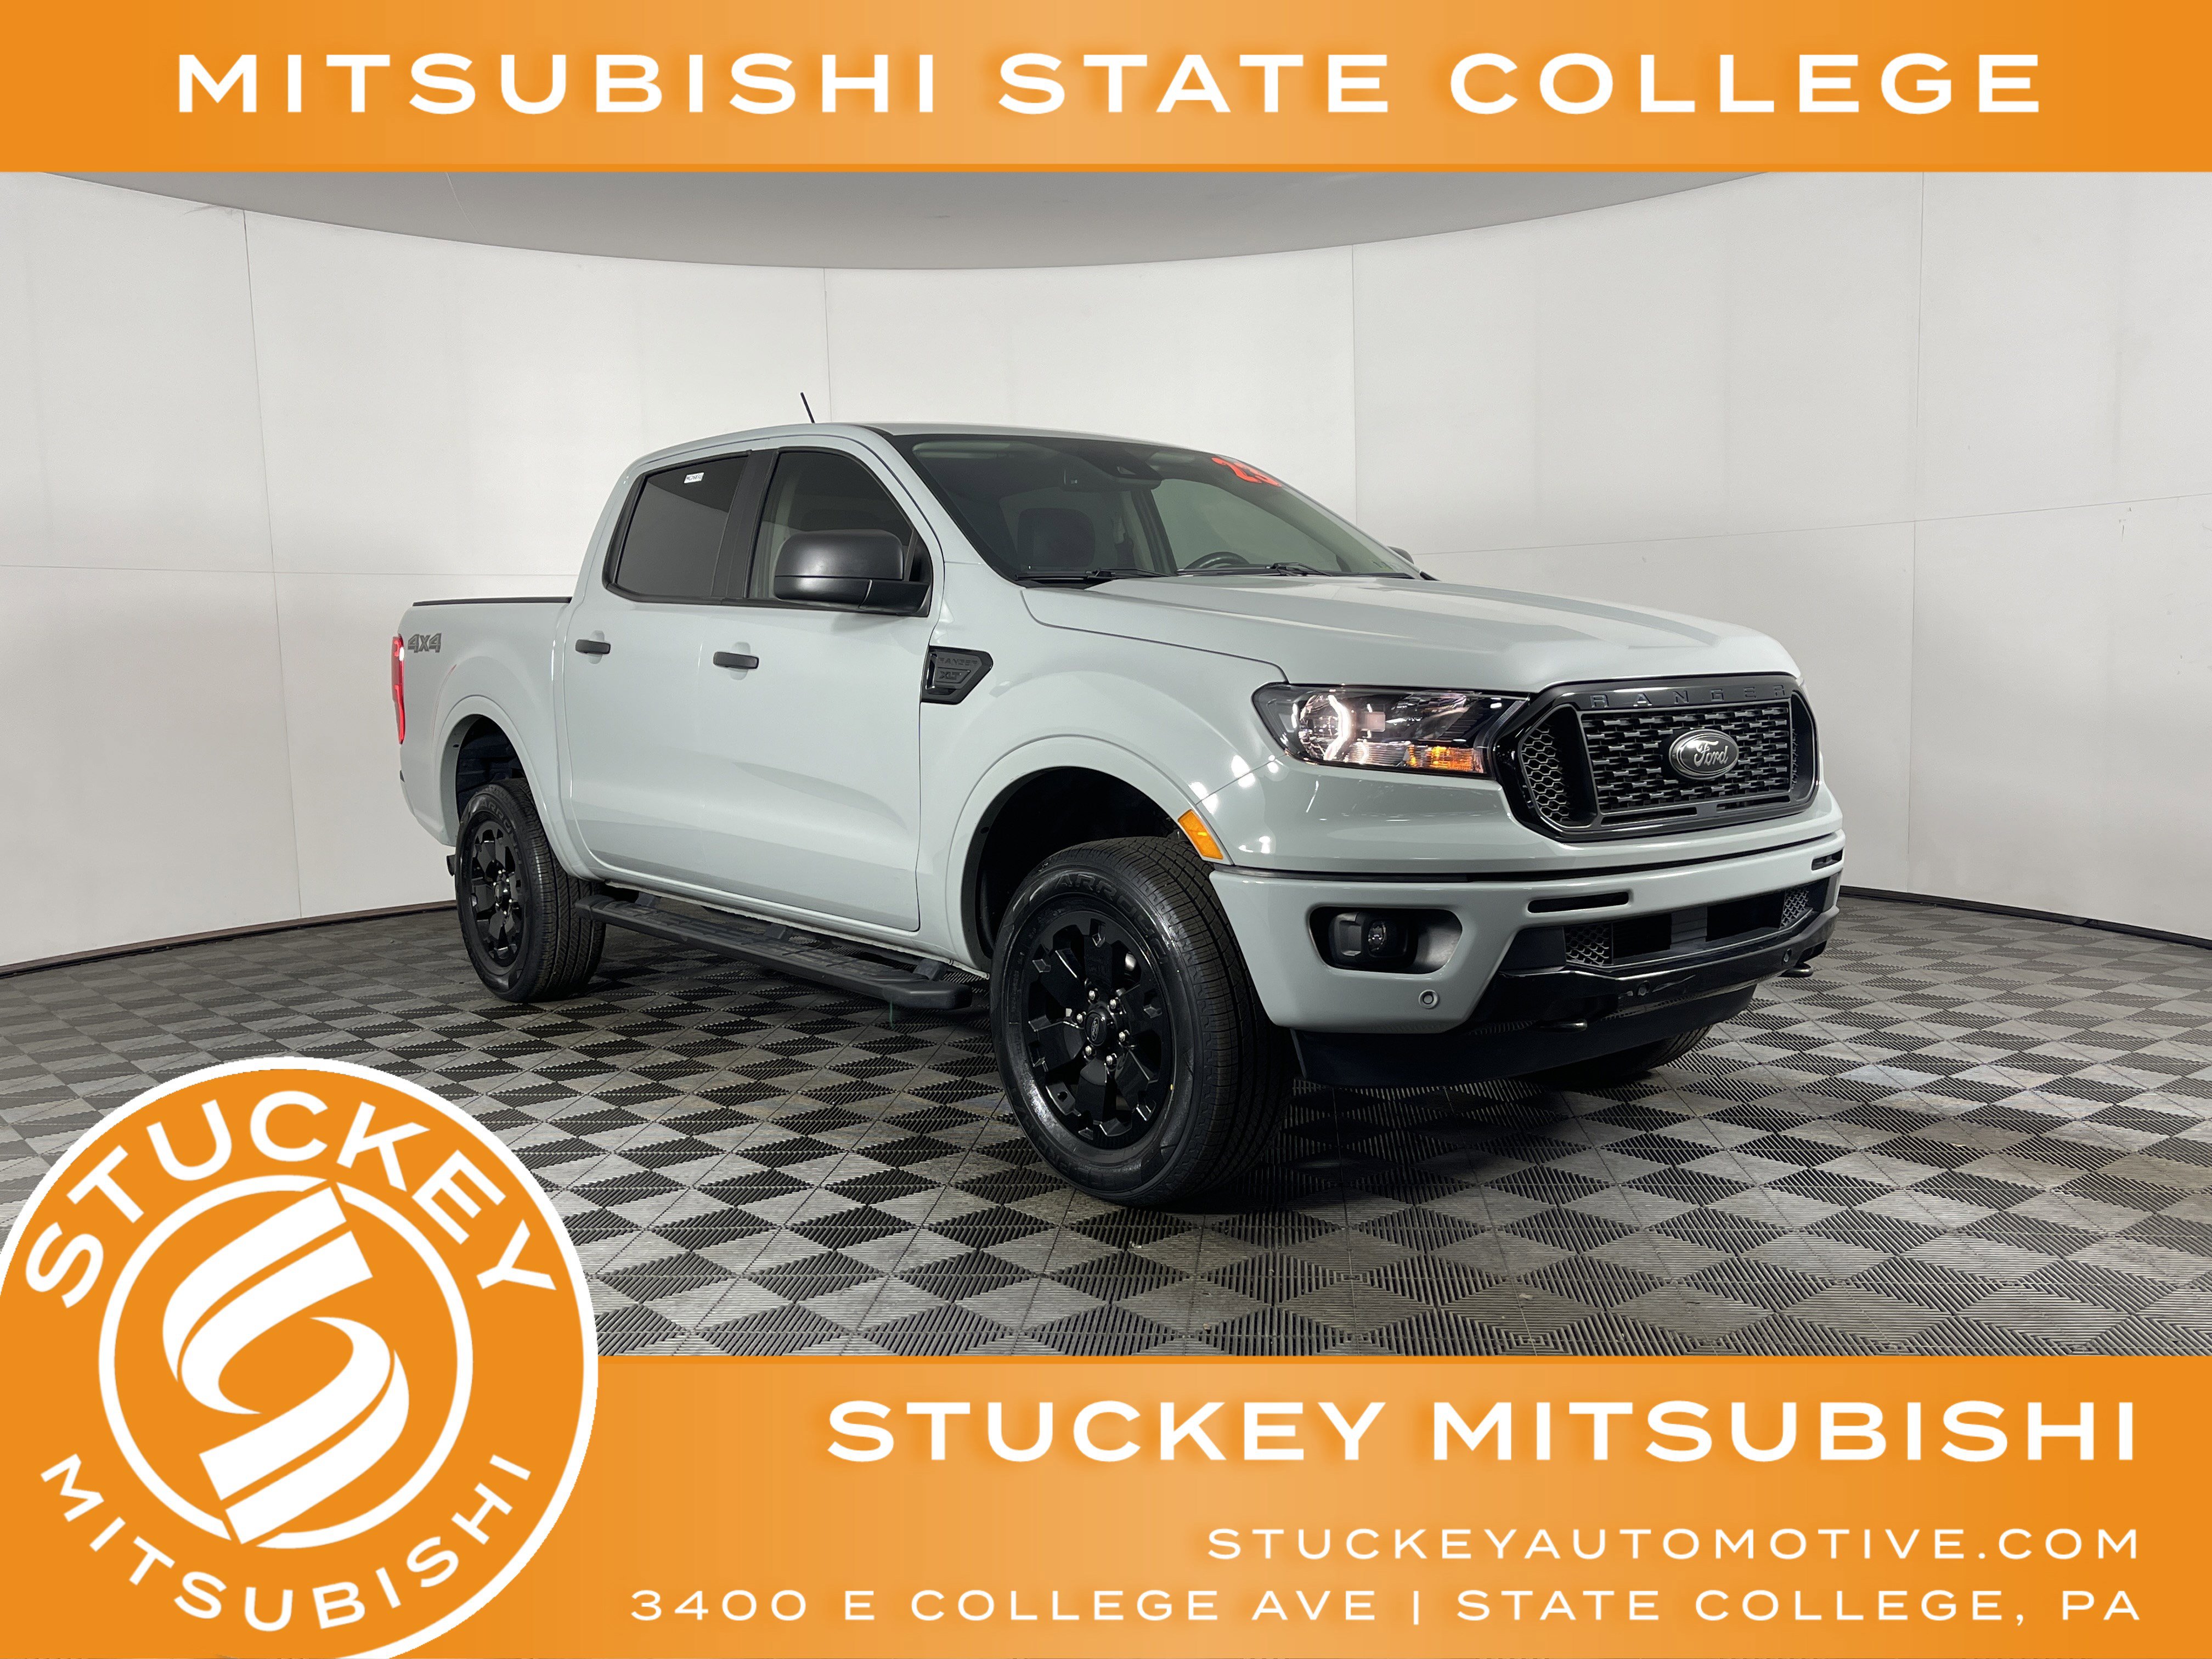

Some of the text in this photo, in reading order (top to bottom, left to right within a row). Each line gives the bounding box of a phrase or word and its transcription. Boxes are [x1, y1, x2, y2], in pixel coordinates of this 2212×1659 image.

[938, 657, 979, 667] RANGER
[939, 671, 960, 680] XLT
[1590, 685, 1786, 708] RANGER
[1694, 740, 1729, 767] Ford
